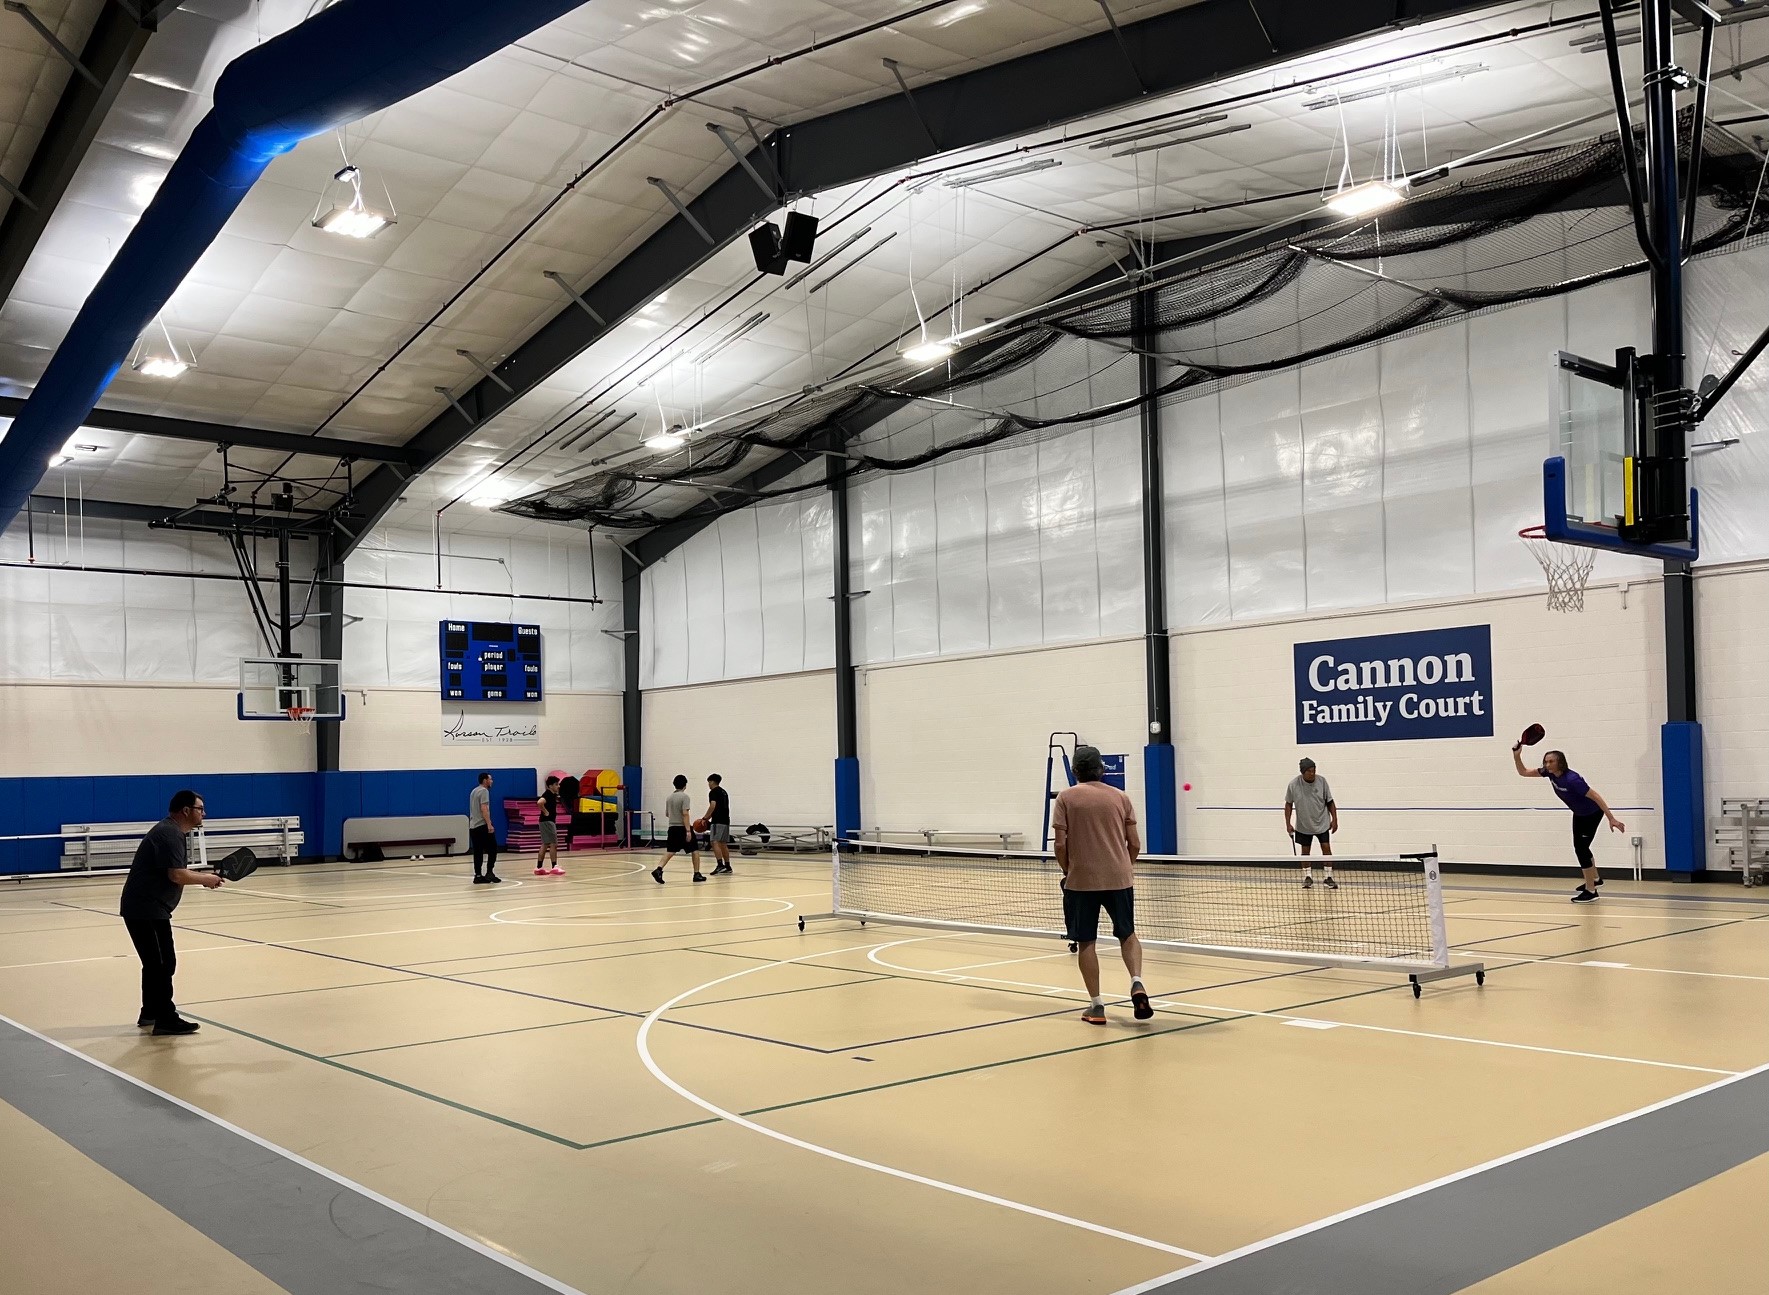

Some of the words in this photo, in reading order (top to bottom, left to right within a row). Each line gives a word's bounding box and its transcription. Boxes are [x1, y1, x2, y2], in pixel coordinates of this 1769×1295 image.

[448, 623, 465, 632] Home
[518, 627, 538, 636] Guests
[484, 651, 503, 660] period
[448, 662, 462, 670] fouls
[484, 663, 503, 672] player
[524, 665, 538, 673] fouls
[1308, 652, 1475, 692] Cannon
[487, 690, 502, 698] game
[1302, 695, 1393, 726] Family
[1399, 690, 1484, 719] Court
